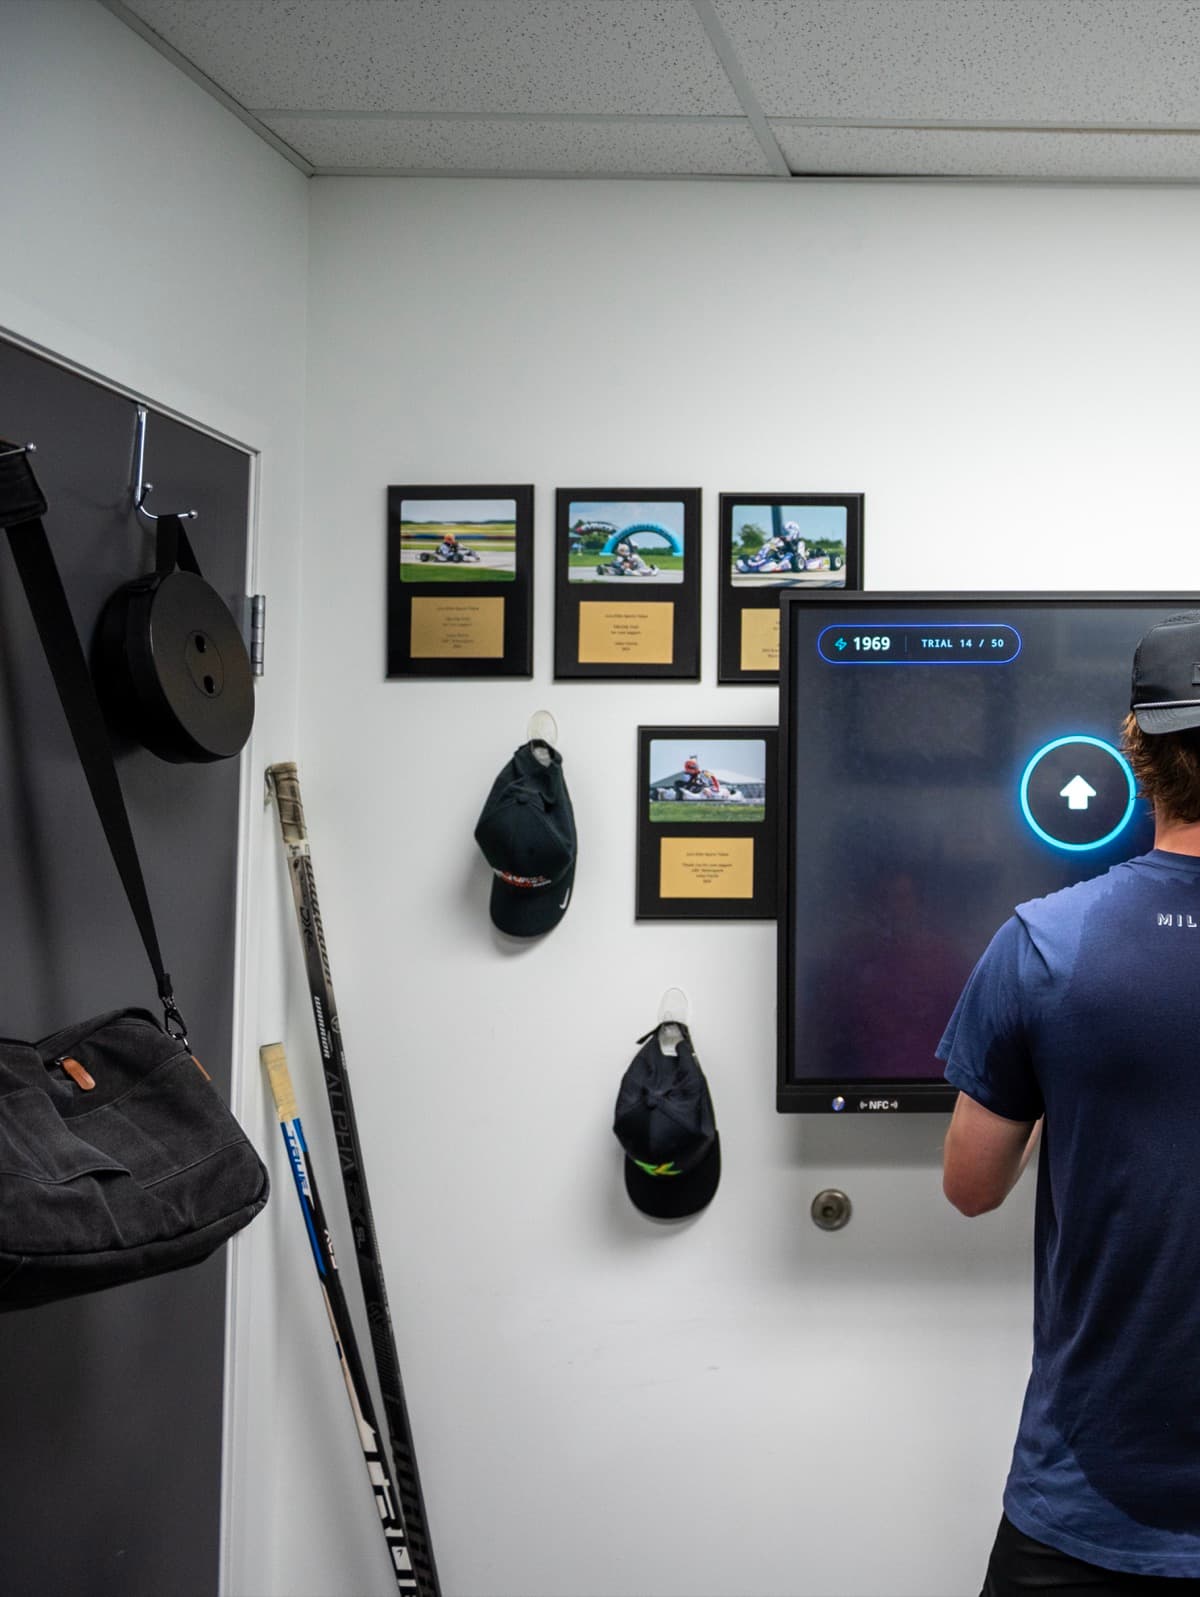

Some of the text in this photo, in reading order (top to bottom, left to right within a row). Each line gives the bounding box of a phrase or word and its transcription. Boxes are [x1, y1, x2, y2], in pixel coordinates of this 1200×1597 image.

[853, 636, 891, 651] 1969
[921, 638, 953, 648] TRIAL
[960, 638, 972, 648] 14
[991, 638, 1004, 648] 50
[314, 995, 331, 1059] WARRIOR
[868, 1100, 889, 1109] NFC
[326, 1072, 355, 1171] ALPHA
